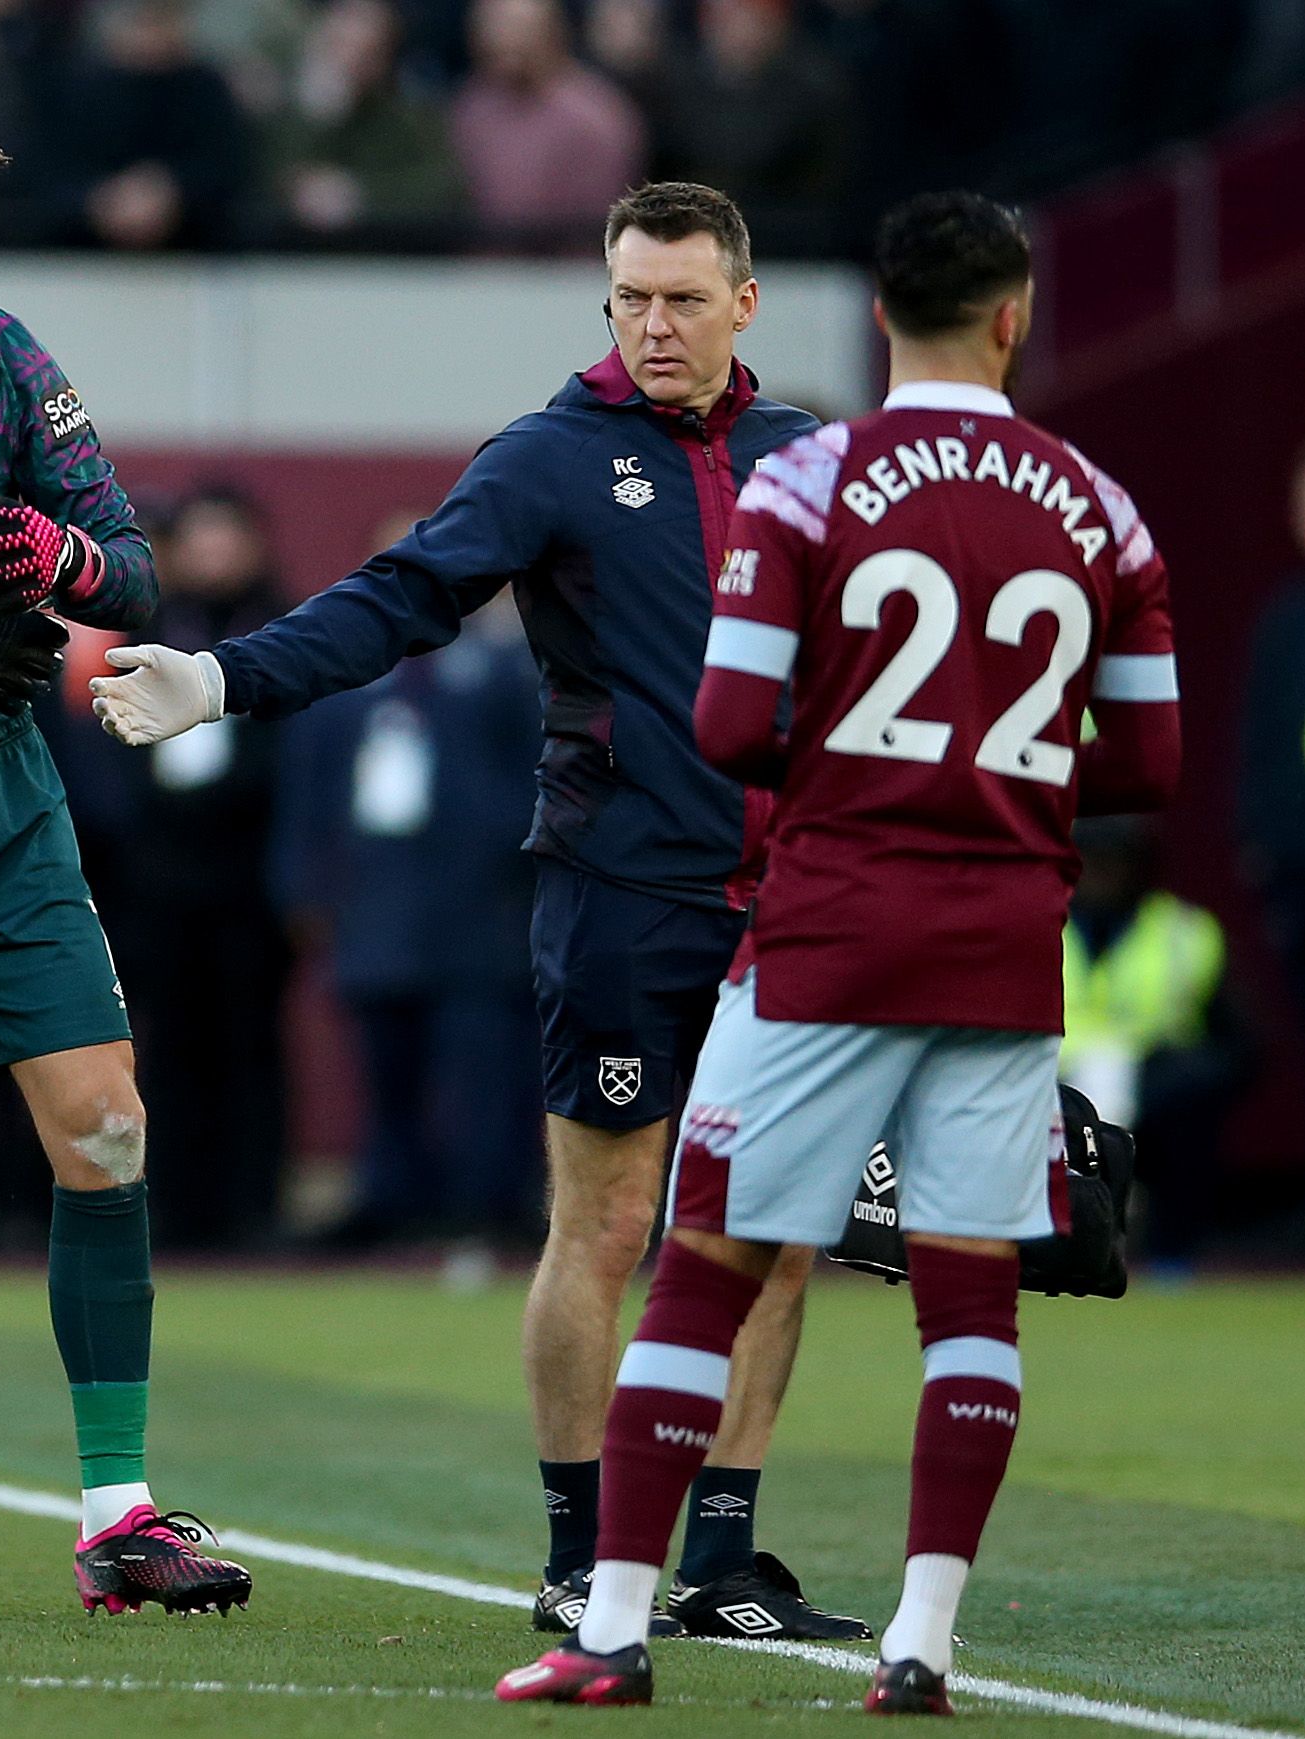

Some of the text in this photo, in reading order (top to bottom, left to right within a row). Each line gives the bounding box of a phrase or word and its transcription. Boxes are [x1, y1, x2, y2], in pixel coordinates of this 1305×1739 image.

[612, 456, 643, 475] RC
[841, 436, 1108, 566] BENRAHMA
[824, 548, 1091, 787] 22
[853, 1199, 896, 1227] umbro
